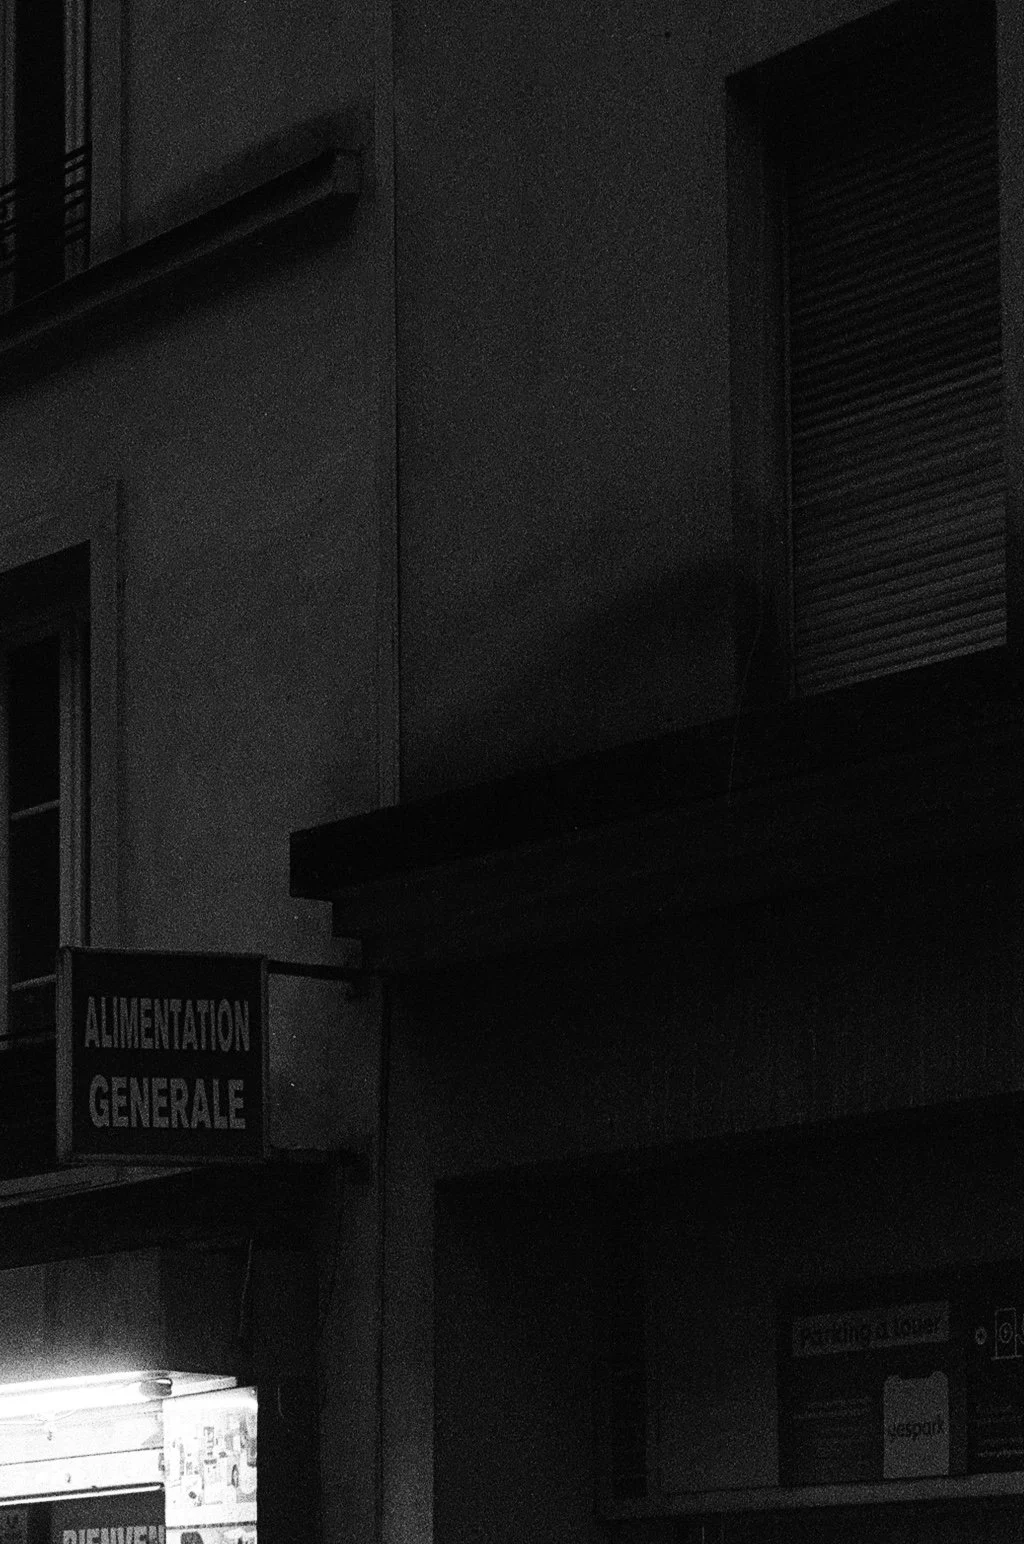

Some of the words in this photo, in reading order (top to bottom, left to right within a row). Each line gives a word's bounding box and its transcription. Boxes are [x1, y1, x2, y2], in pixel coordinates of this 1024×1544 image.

[84, 997, 250, 1052] ALIMENTATION
[89, 1075, 246, 1129] GENERALE
[887, 1413, 945, 1444] yespark
